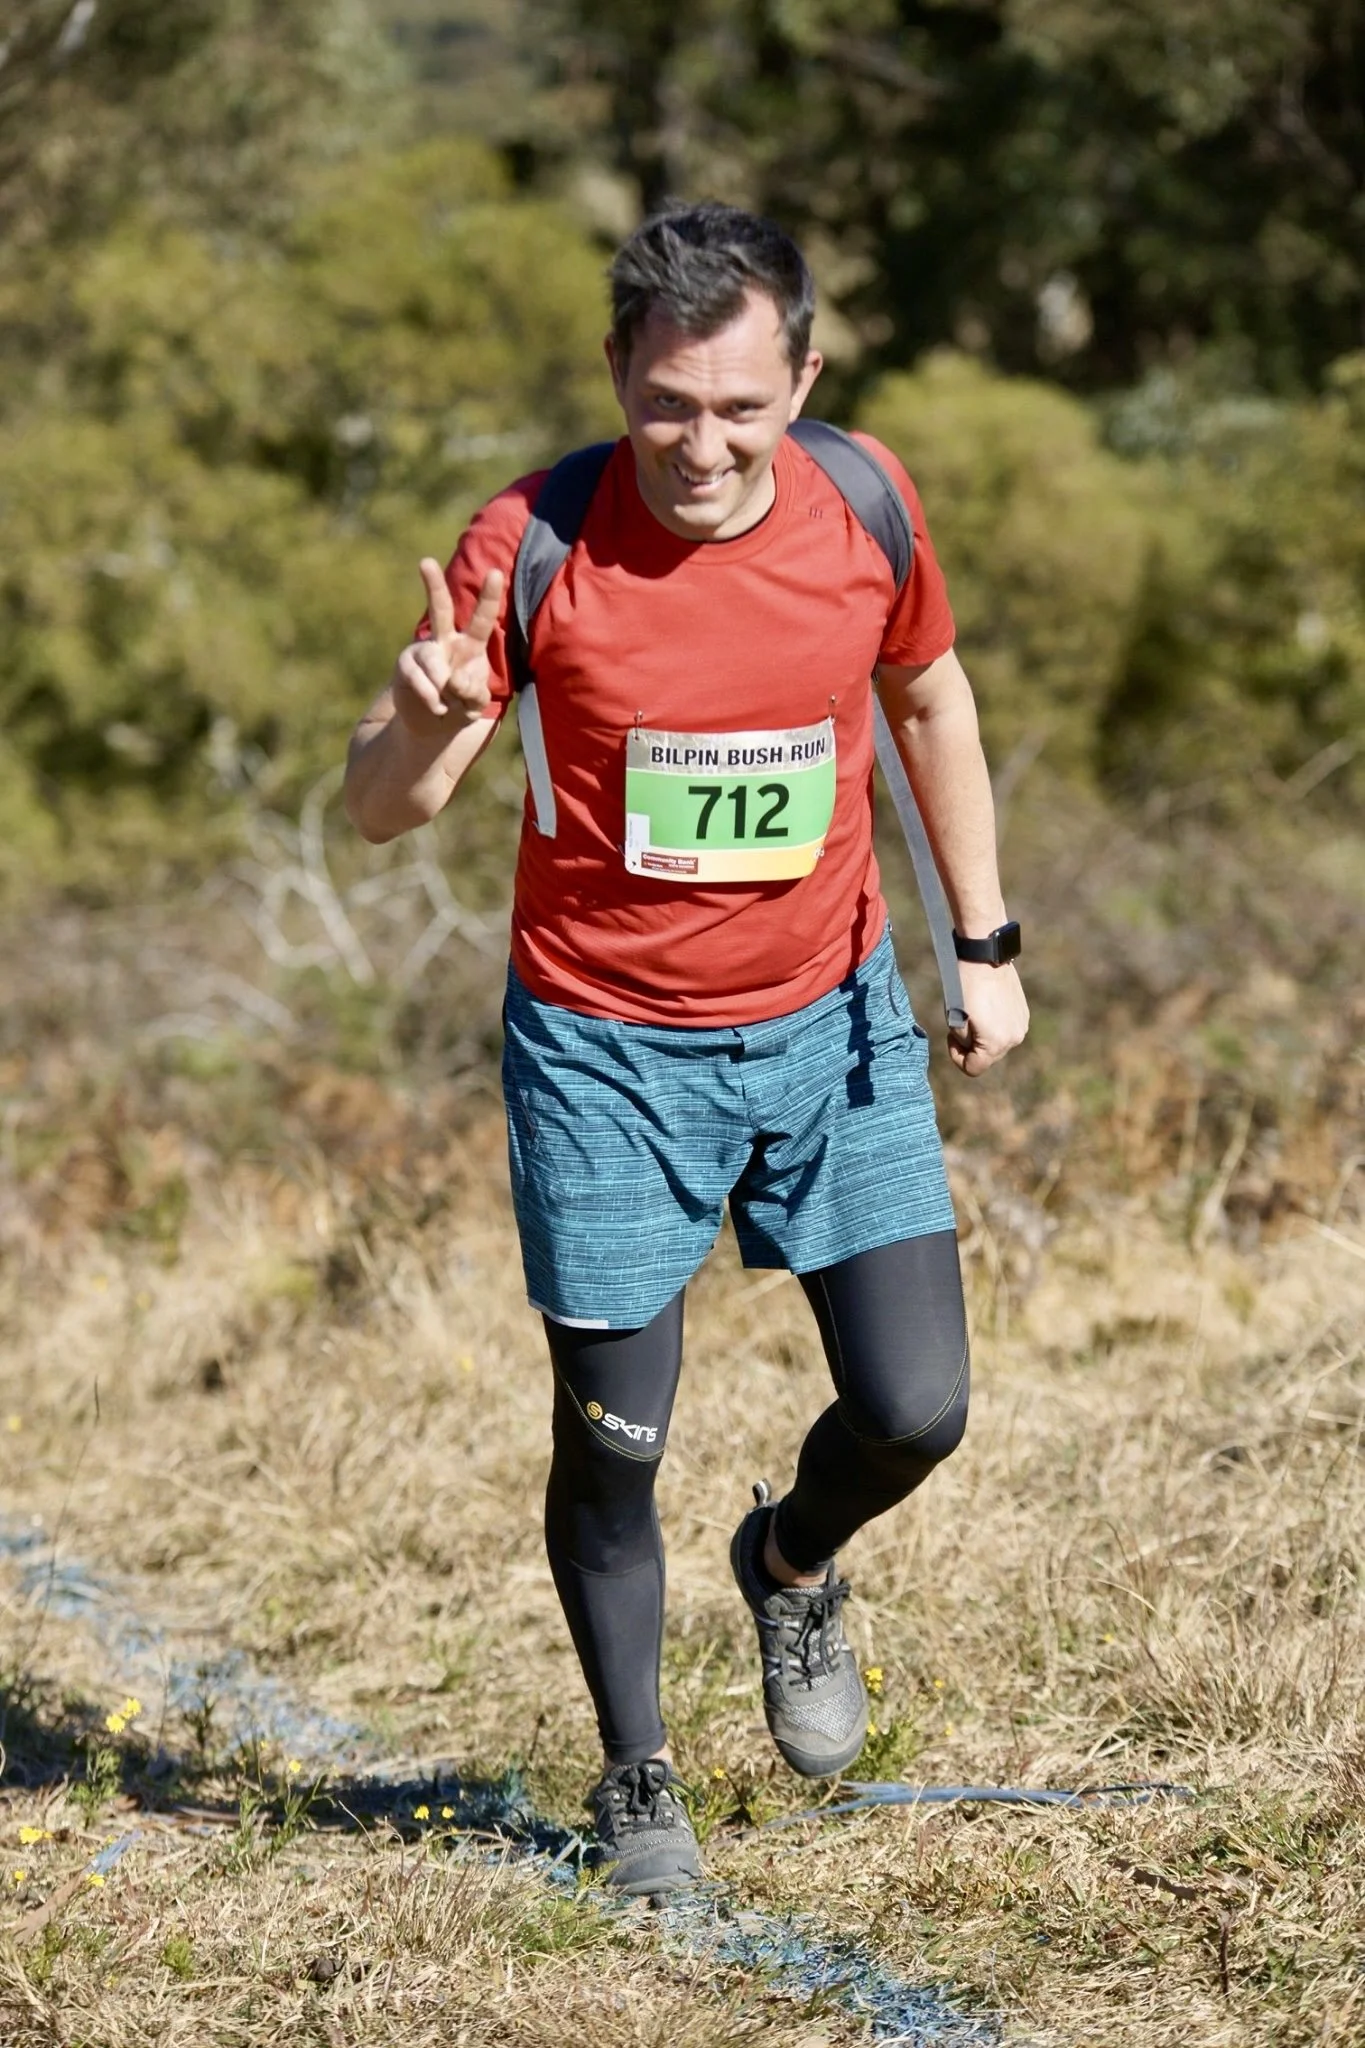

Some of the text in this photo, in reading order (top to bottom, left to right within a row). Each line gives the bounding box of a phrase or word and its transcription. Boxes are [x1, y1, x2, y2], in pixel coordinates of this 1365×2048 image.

[651, 737, 826, 766] BILPIN BUSH RUN
[688, 783, 790, 840] 712
[642, 853, 677, 865] Community
